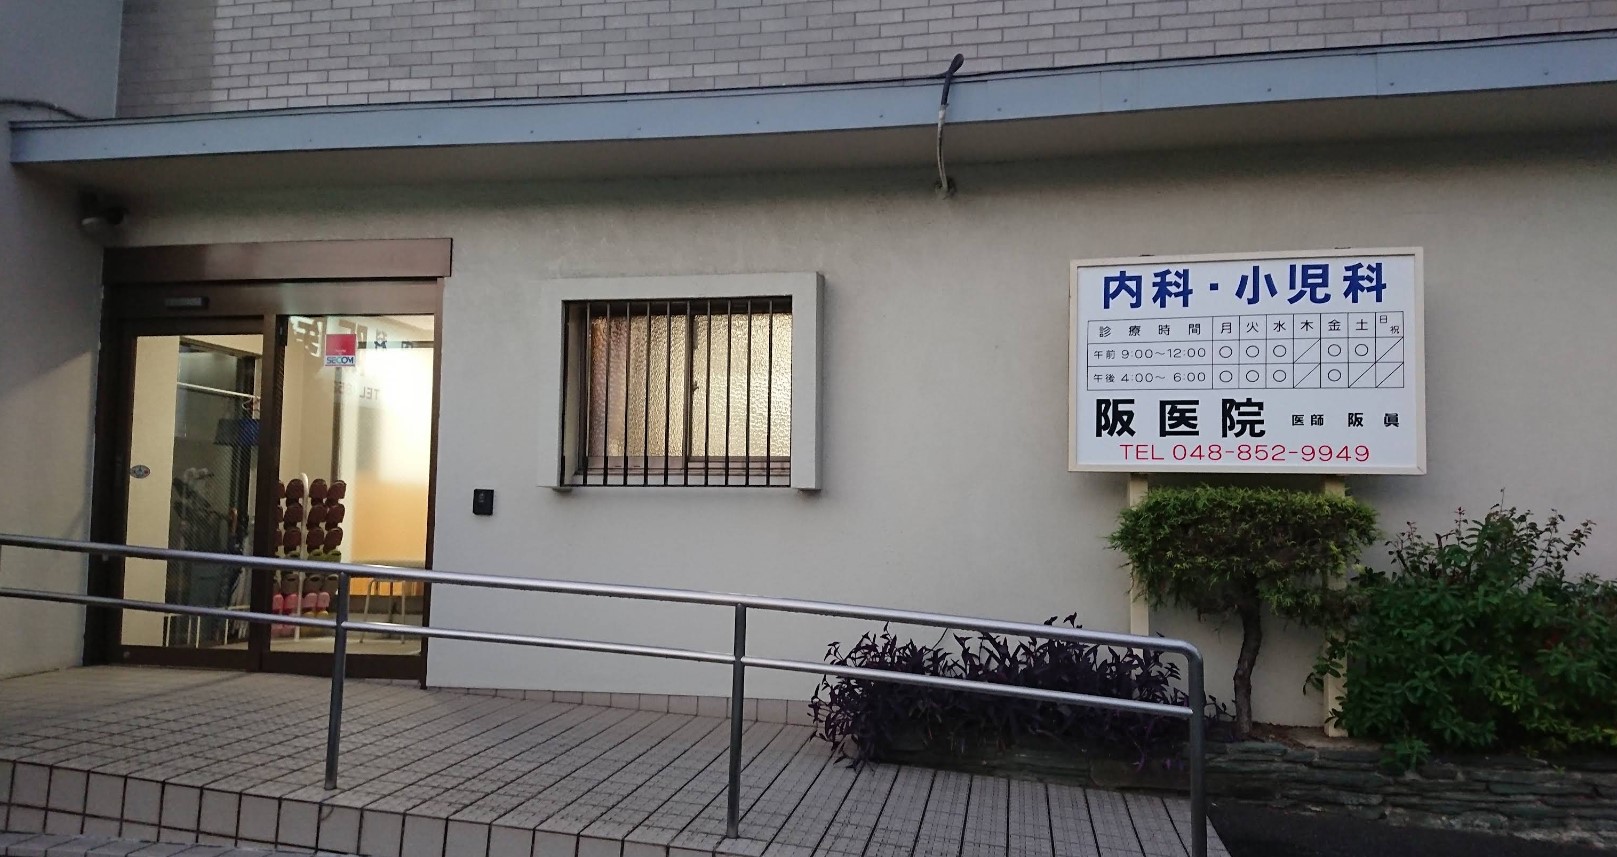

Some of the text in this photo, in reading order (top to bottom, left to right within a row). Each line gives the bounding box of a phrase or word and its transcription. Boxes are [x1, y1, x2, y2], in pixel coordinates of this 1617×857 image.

[1103, 262, 1387, 309] 内科・小児科
[1098, 315, 1400, 338] 診療時間 月 火 水 木 金 土 日 祝
[326, 356, 354, 365] SECOM
[1093, 350, 1116, 360] 午前
[1093, 373, 1116, 383] 午後
[1095, 397, 1266, 438] 阪医院
[1291, 414, 1324, 427] 医師
[1119, 443, 1370, 462] TEL 048-852-9949
